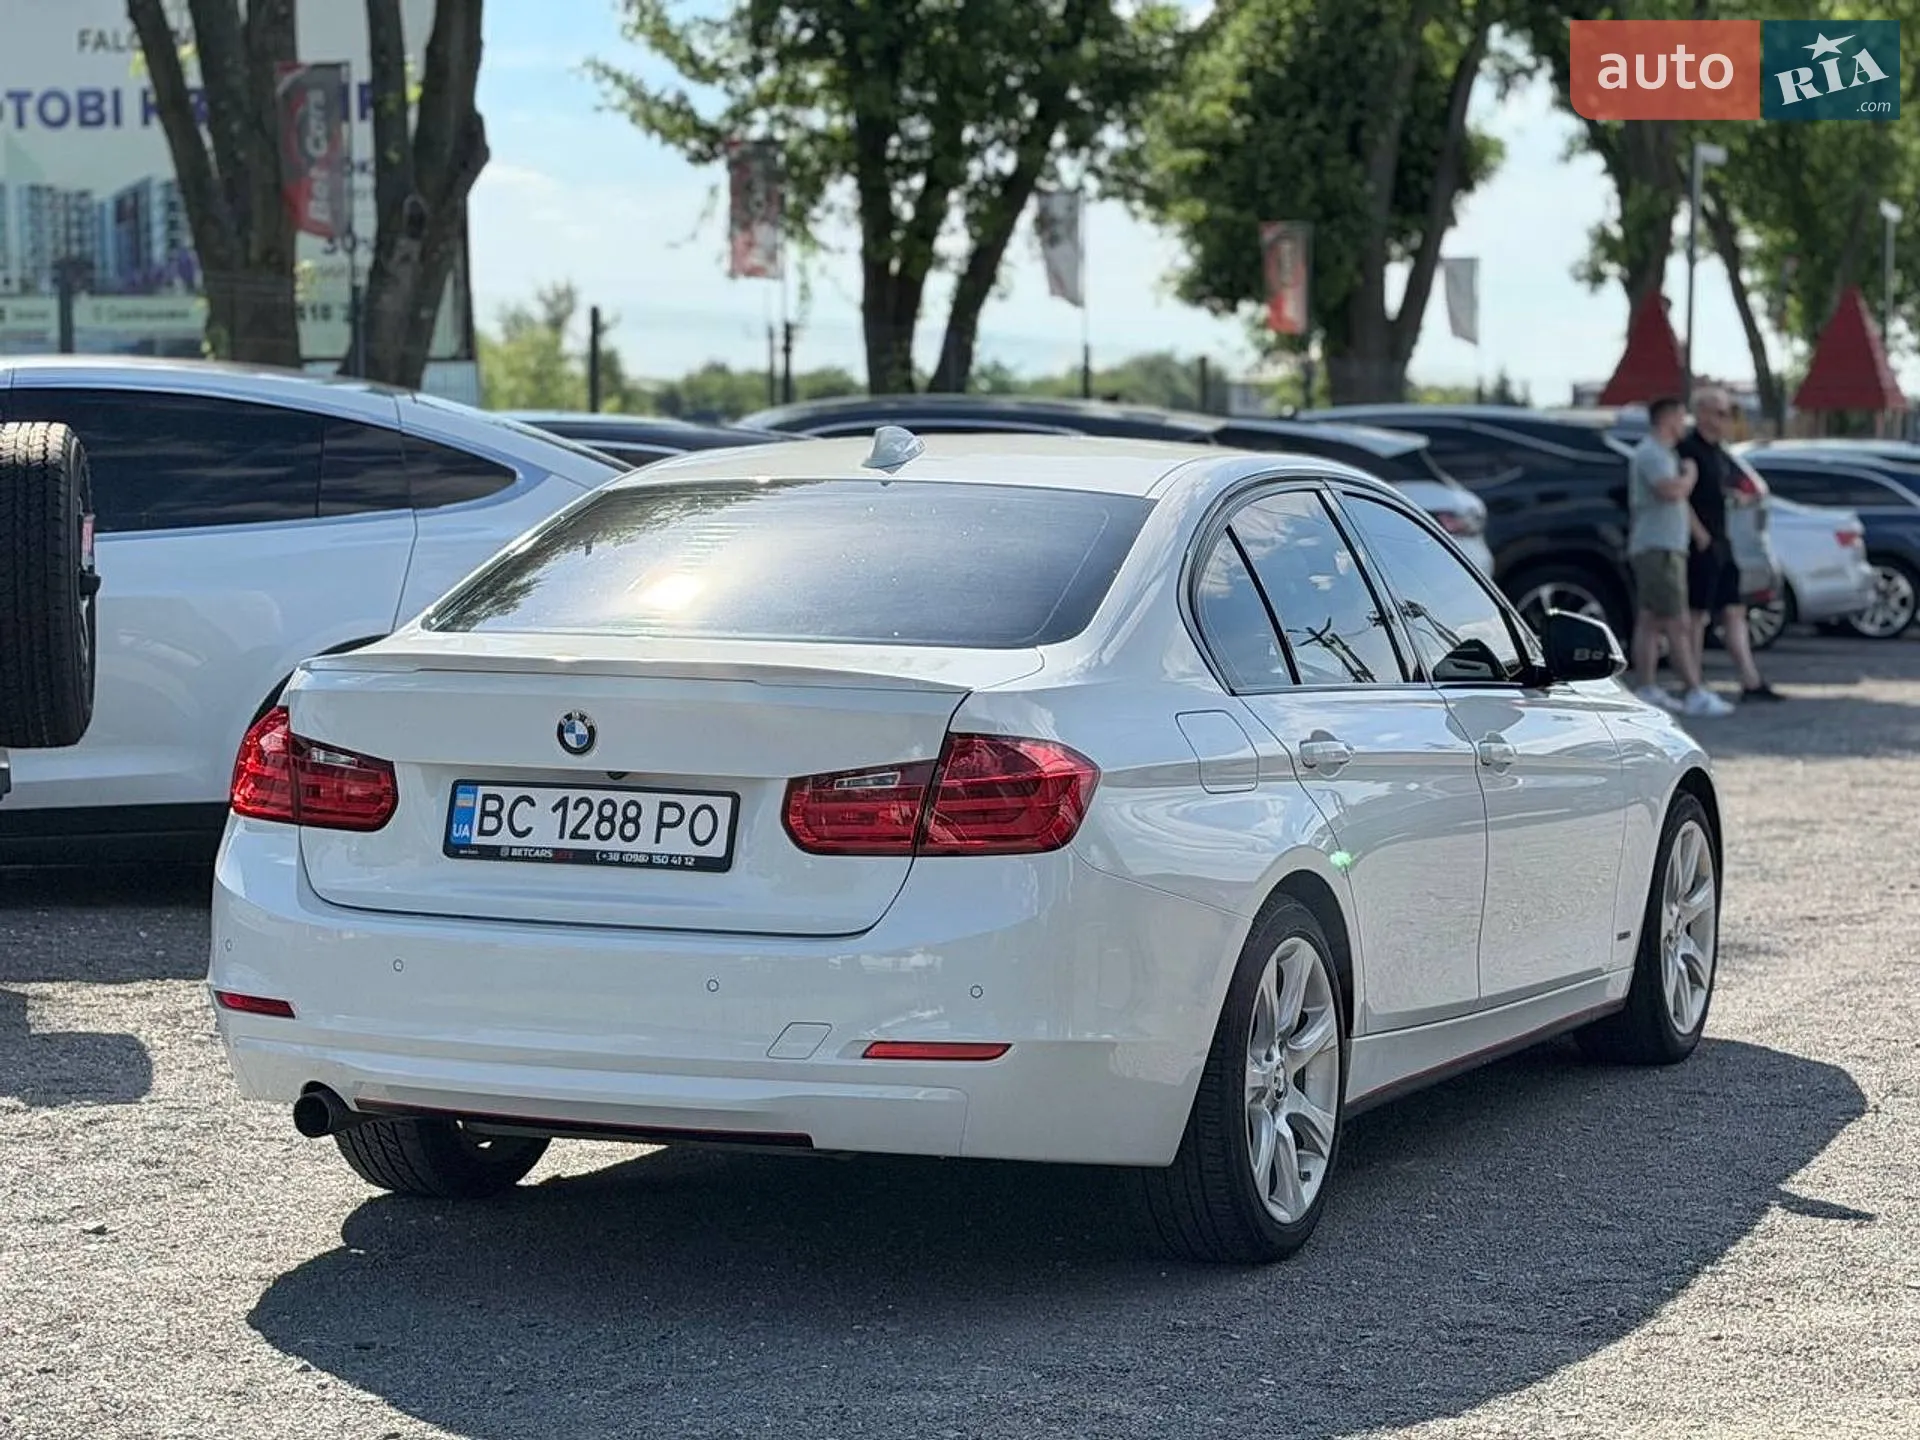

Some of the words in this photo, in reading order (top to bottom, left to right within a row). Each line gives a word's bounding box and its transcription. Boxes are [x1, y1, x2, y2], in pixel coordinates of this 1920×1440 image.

[0, 89, 122, 129] ТОВІ
[452, 823, 471, 839] UA
[477, 793, 536, 839] BC
[551, 796, 643, 843] 1288
[654, 801, 719, 848] PO
